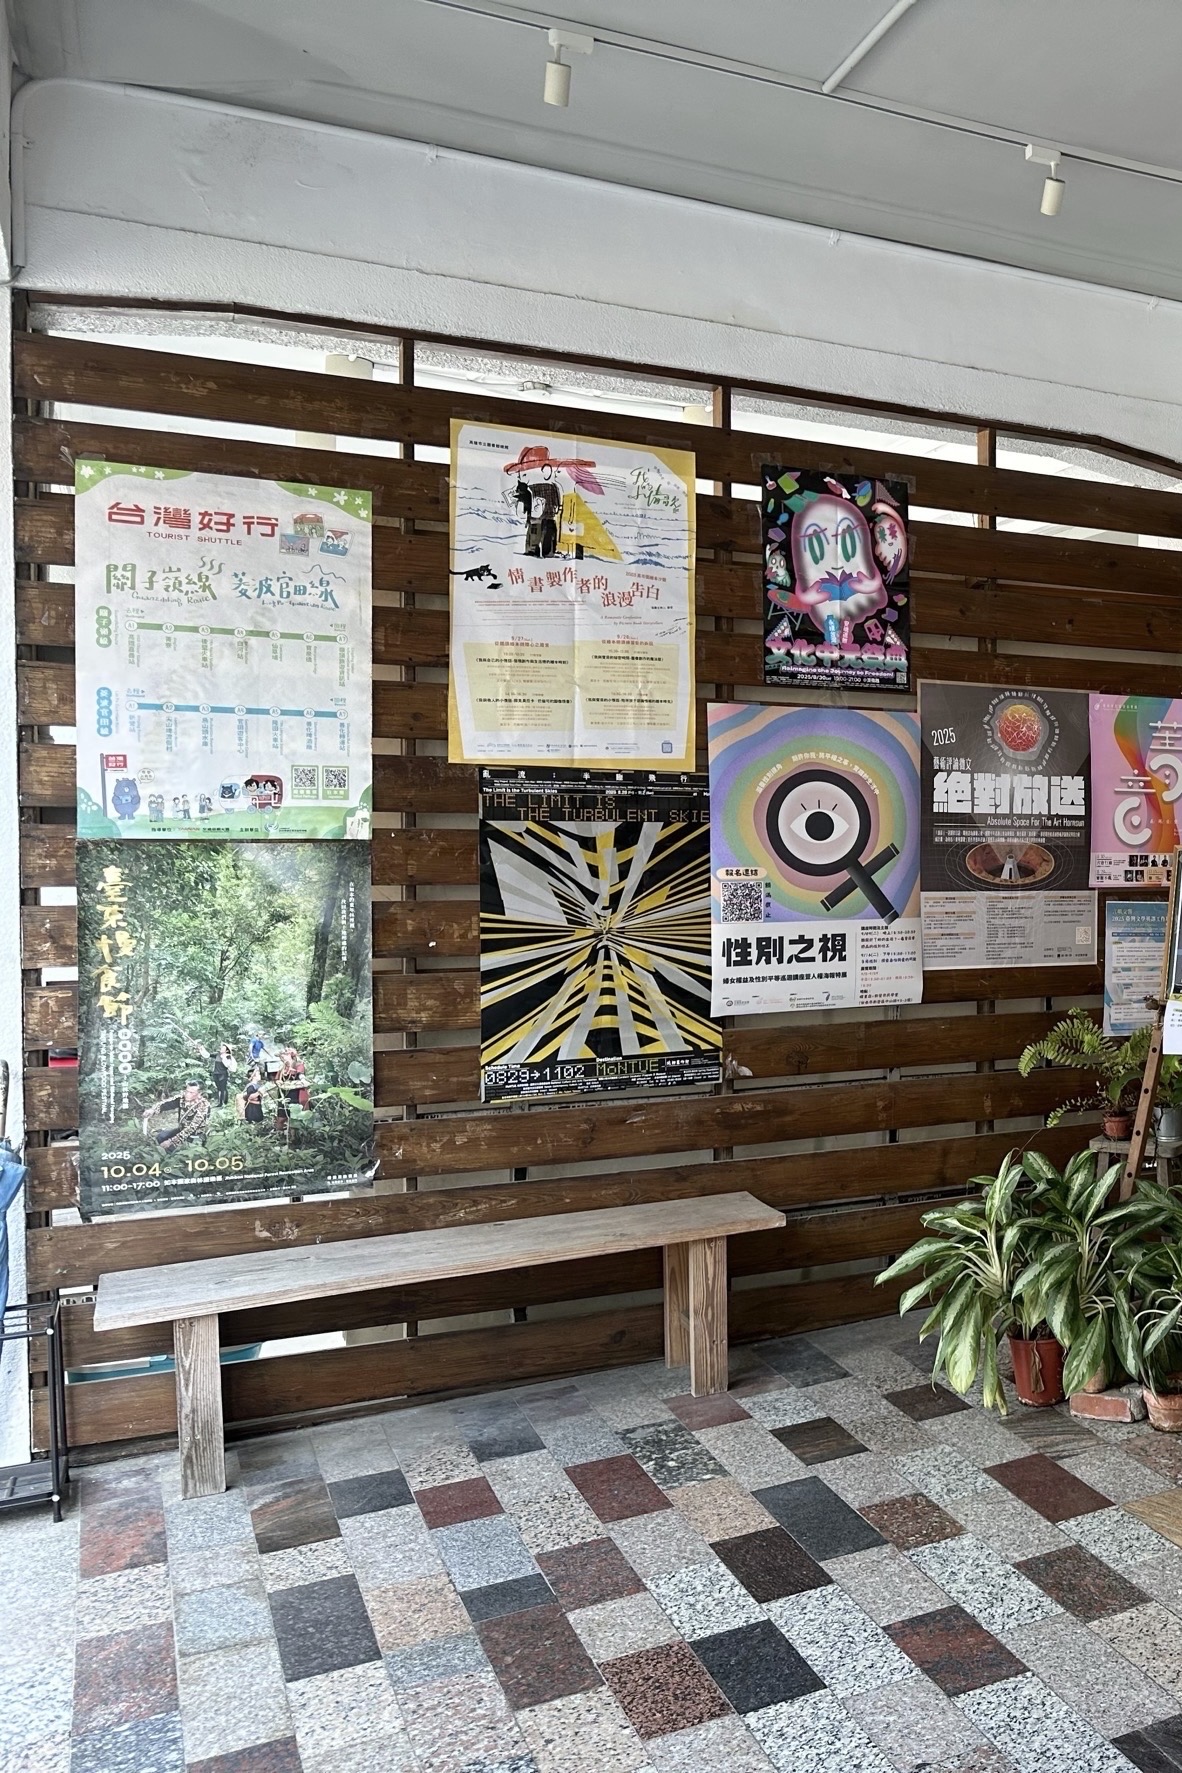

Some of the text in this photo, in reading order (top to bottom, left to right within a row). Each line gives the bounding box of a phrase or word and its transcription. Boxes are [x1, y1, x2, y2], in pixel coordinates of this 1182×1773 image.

[107, 501, 279, 538] 台灣好行
[147, 531, 242, 546] TOURIST SHUTTLE
[105, 562, 218, 602] 關子嶺線
[232, 570, 340, 608] 菱波官田線
[507, 567, 609, 594] 情書製作者的
[600, 582, 660, 608] 浪漫告白
[932, 728, 956, 746] 2025
[933, 757, 971, 770] 藝術評論徵文
[483, 794, 615, 808] THE LIMIT IS
[933, 772, 1085, 816] 絕對放送
[517, 808, 550, 820] THE
[562, 808, 658, 822] TURBULENT
[987, 817, 1011, 826] Absolute
[1013, 817, 1029, 827] Space
[1031, 817, 1040, 826] For
[1042, 817, 1052, 826] The
[1053, 817, 1062, 826] Art
[726, 869, 759, 877] 報名連結
[722, 933, 847, 967] 性別之視
[596, 1059, 659, 1076] MoNTUE
[101, 1151, 130, 1160] 2025
[101, 1156, 243, 1178] 10.04 10.05
[102, 1180, 160, 1192] 11:00-17:00
